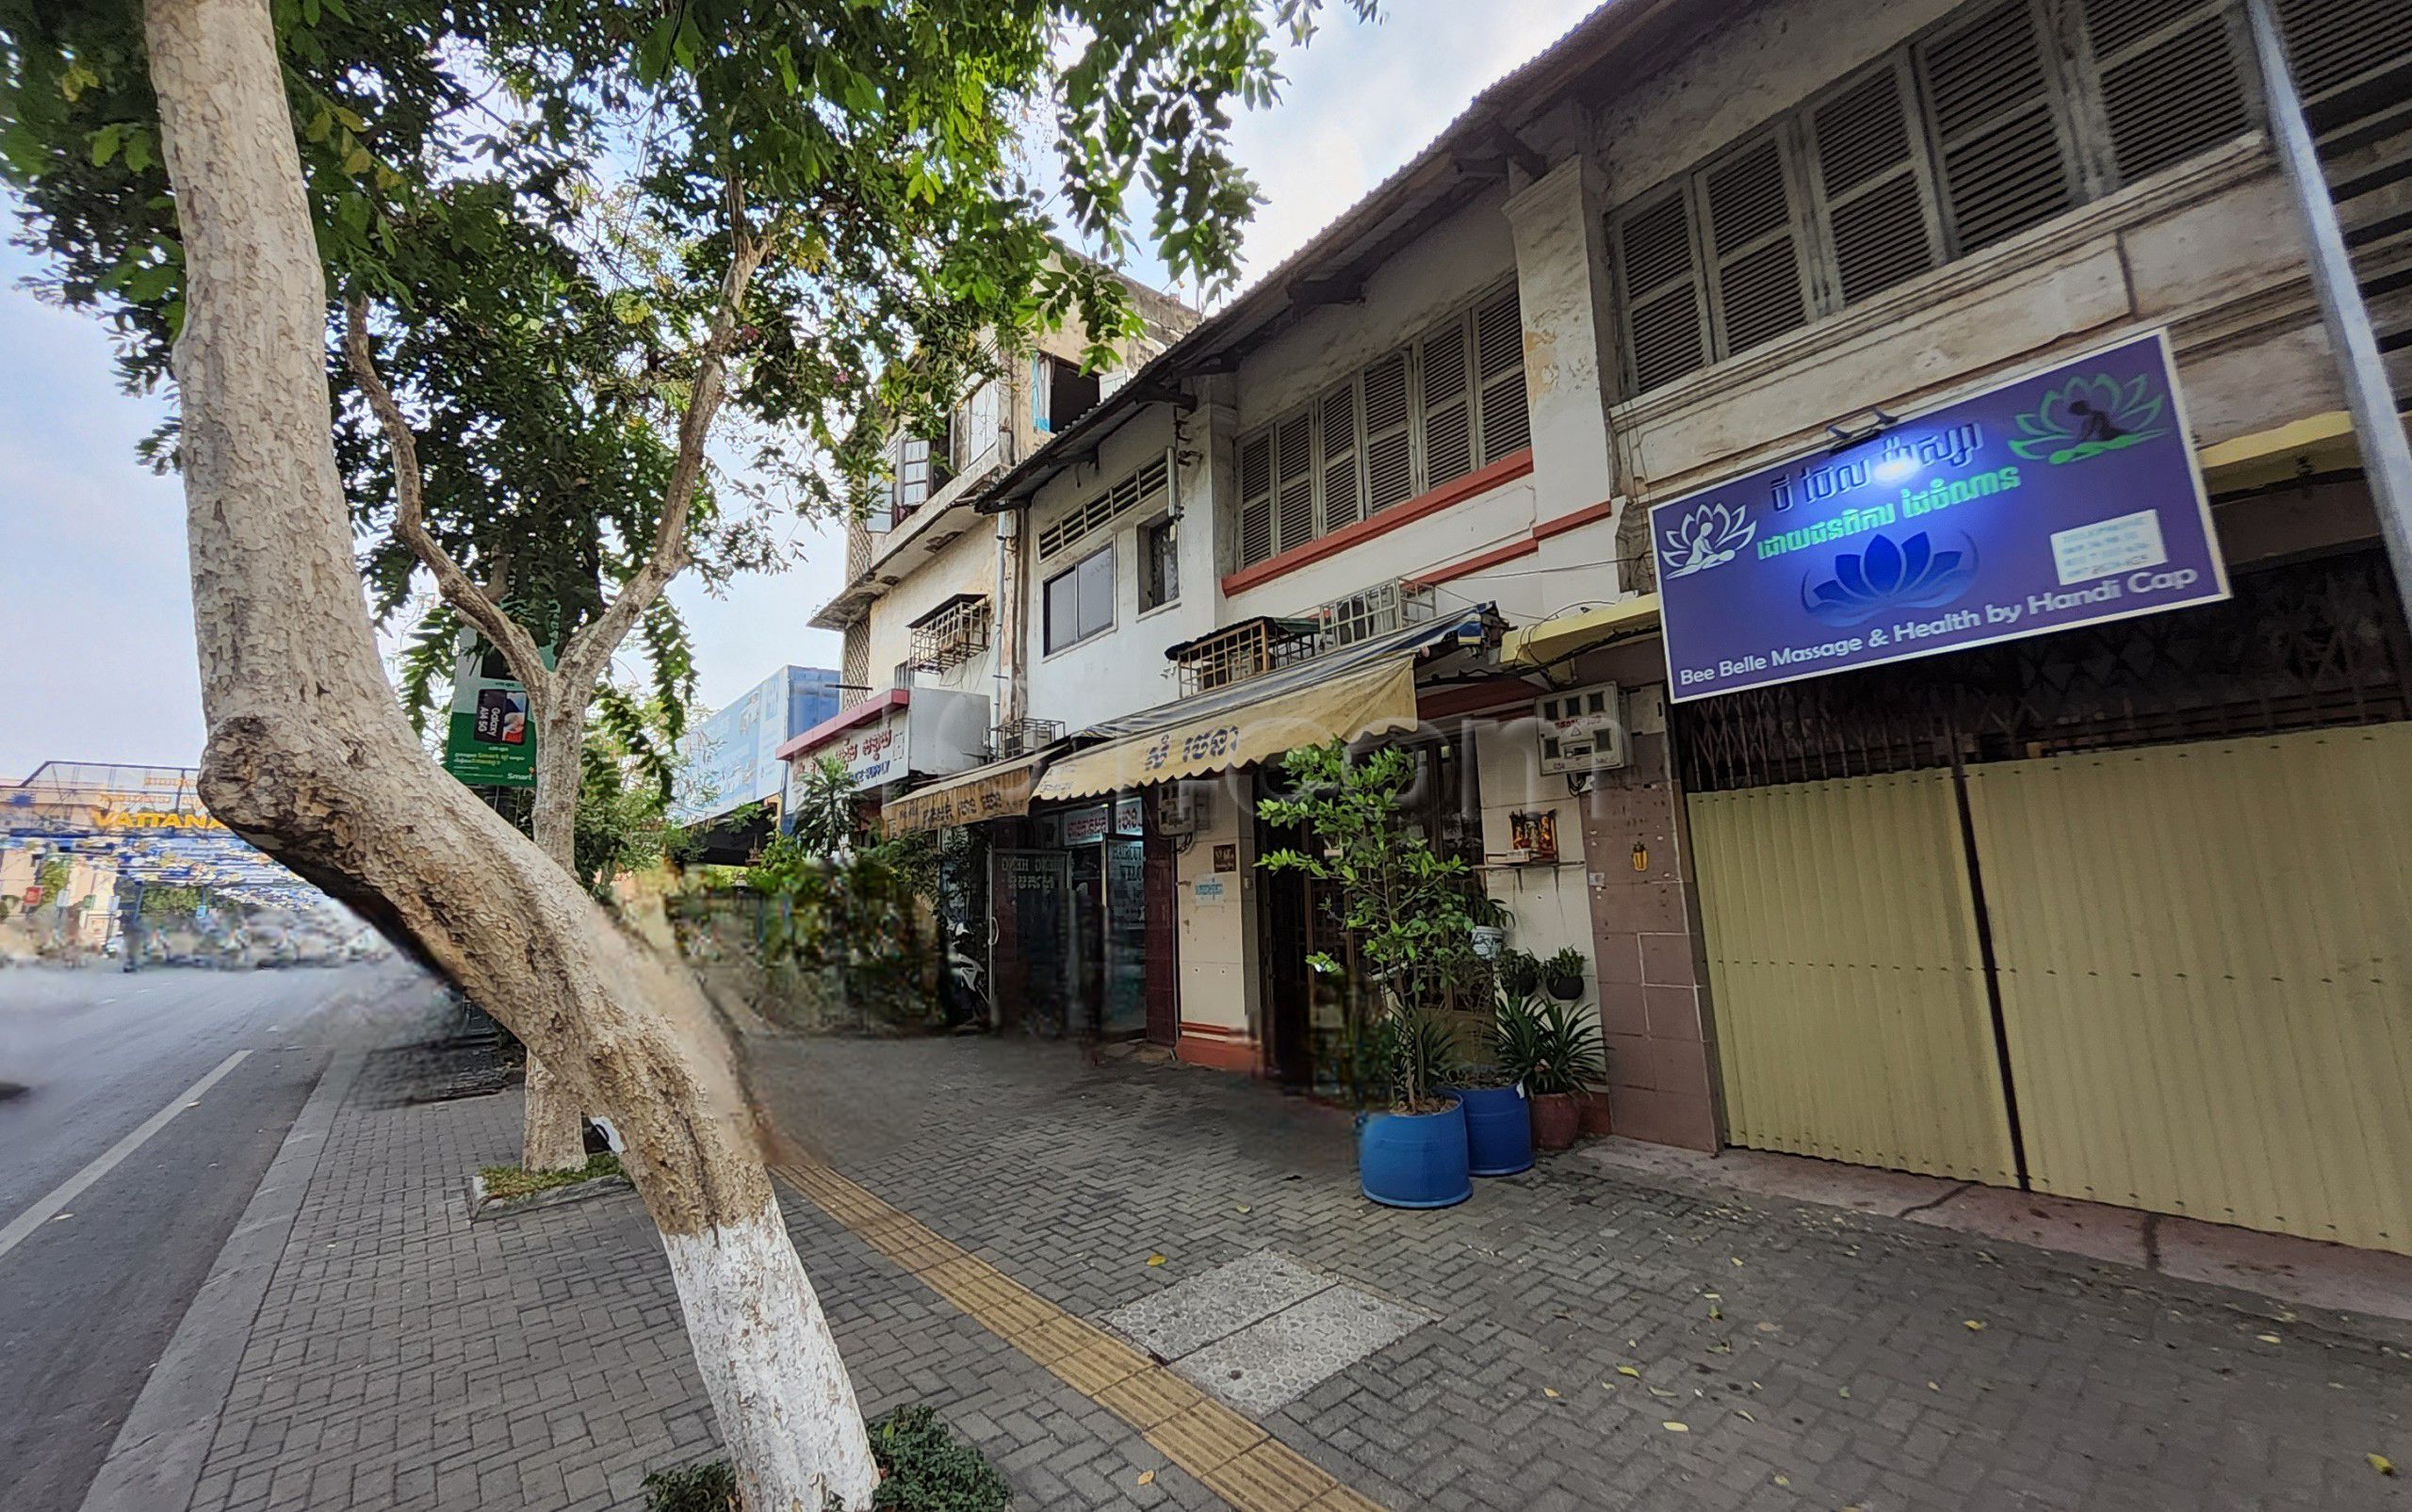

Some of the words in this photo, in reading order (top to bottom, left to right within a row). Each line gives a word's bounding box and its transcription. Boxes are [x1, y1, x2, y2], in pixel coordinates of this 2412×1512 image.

[1680, 667, 1716, 686] Bee
[1719, 655, 1768, 677] Belle
[1770, 635, 1864, 667] Massage
[1868, 627, 1889, 648] &
[1893, 608, 1980, 642] Health
[1984, 602, 2022, 624] by
[2027, 578, 2123, 615] Handi
[2126, 568, 2199, 593] Cap
[487, 707, 501, 737] Galaxy
[507, 772, 533, 781] Smart
